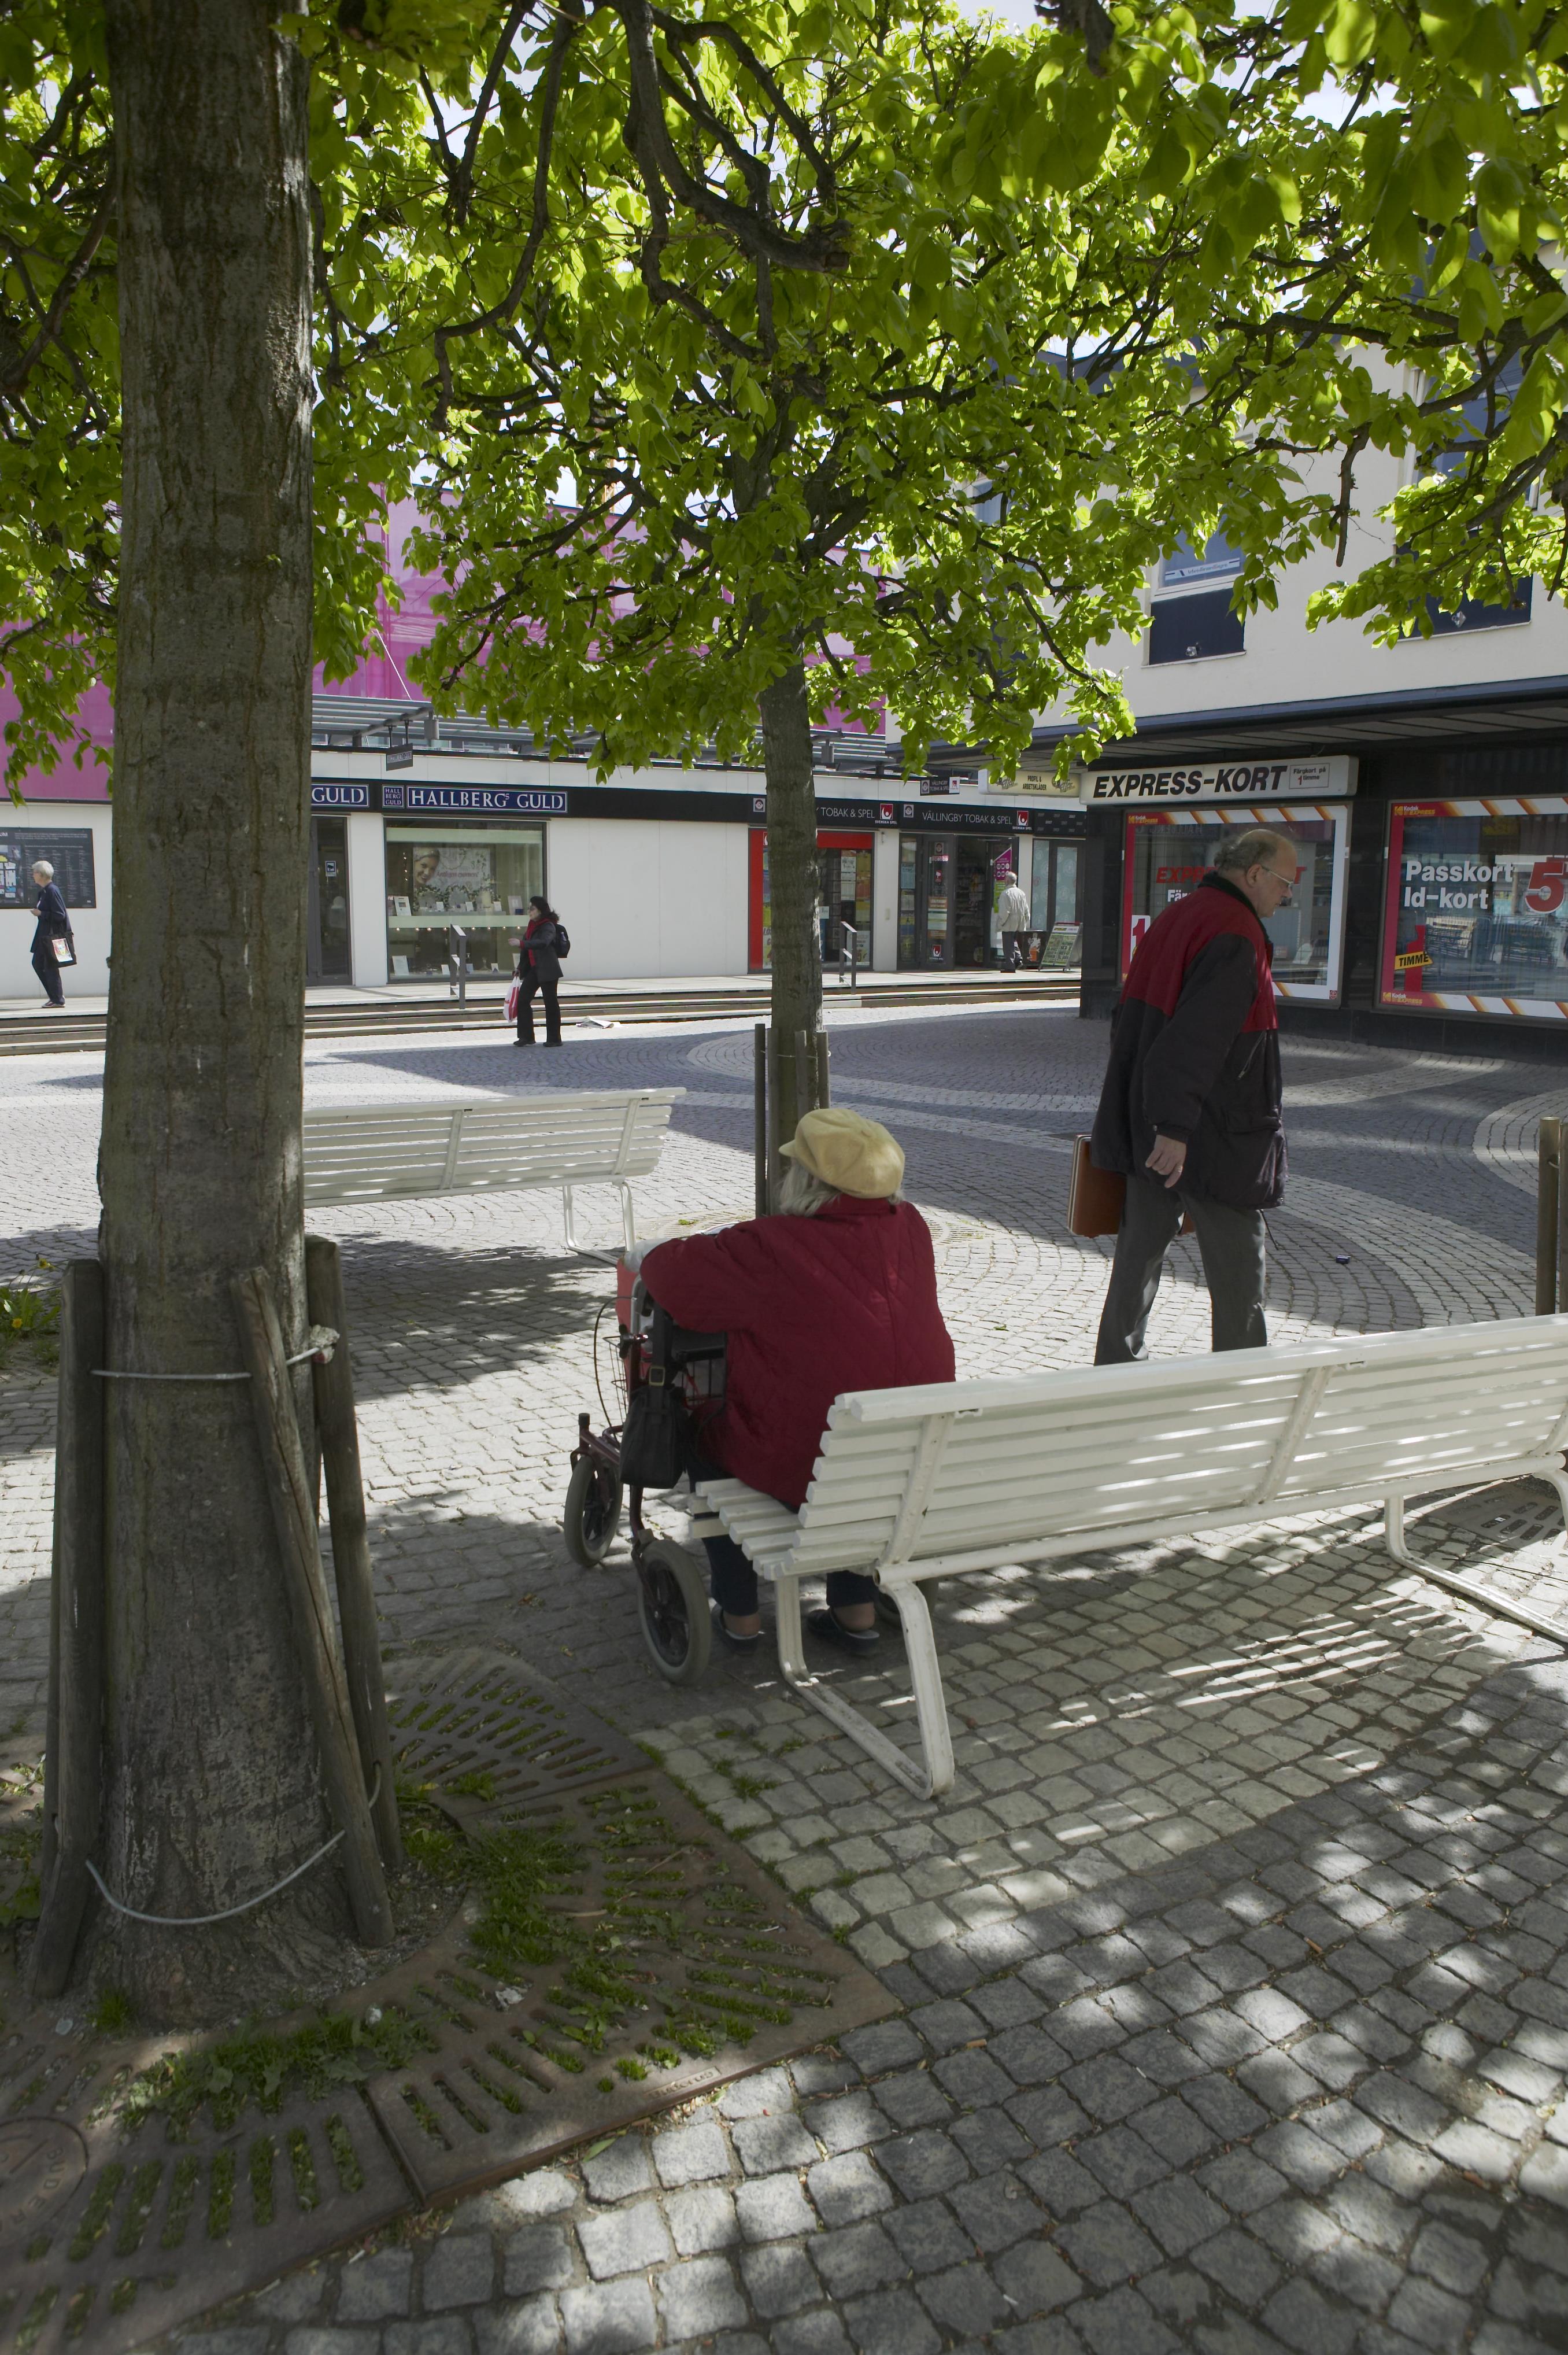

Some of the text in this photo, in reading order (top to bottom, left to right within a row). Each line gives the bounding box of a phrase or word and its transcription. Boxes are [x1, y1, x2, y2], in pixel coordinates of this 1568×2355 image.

[1093, 765, 1288, 798] EXPRESS-KORT
[312, 787, 364, 803] GULD
[517, 794, 563, 809] GULD
[821, 807, 848, 817] TOBAK
[850, 809, 856, 817] &
[858, 809, 875, 818] SPEL
[922, 810, 963, 822] VÄLLINGBY
[964, 814, 989, 824] TOBAK
[997, 816, 1012, 825] SPEL
[1406, 861, 1514, 883] Passkort
[1404, 887, 1489, 909] Id-kort
[1399, 954, 1430, 966] TIMME
